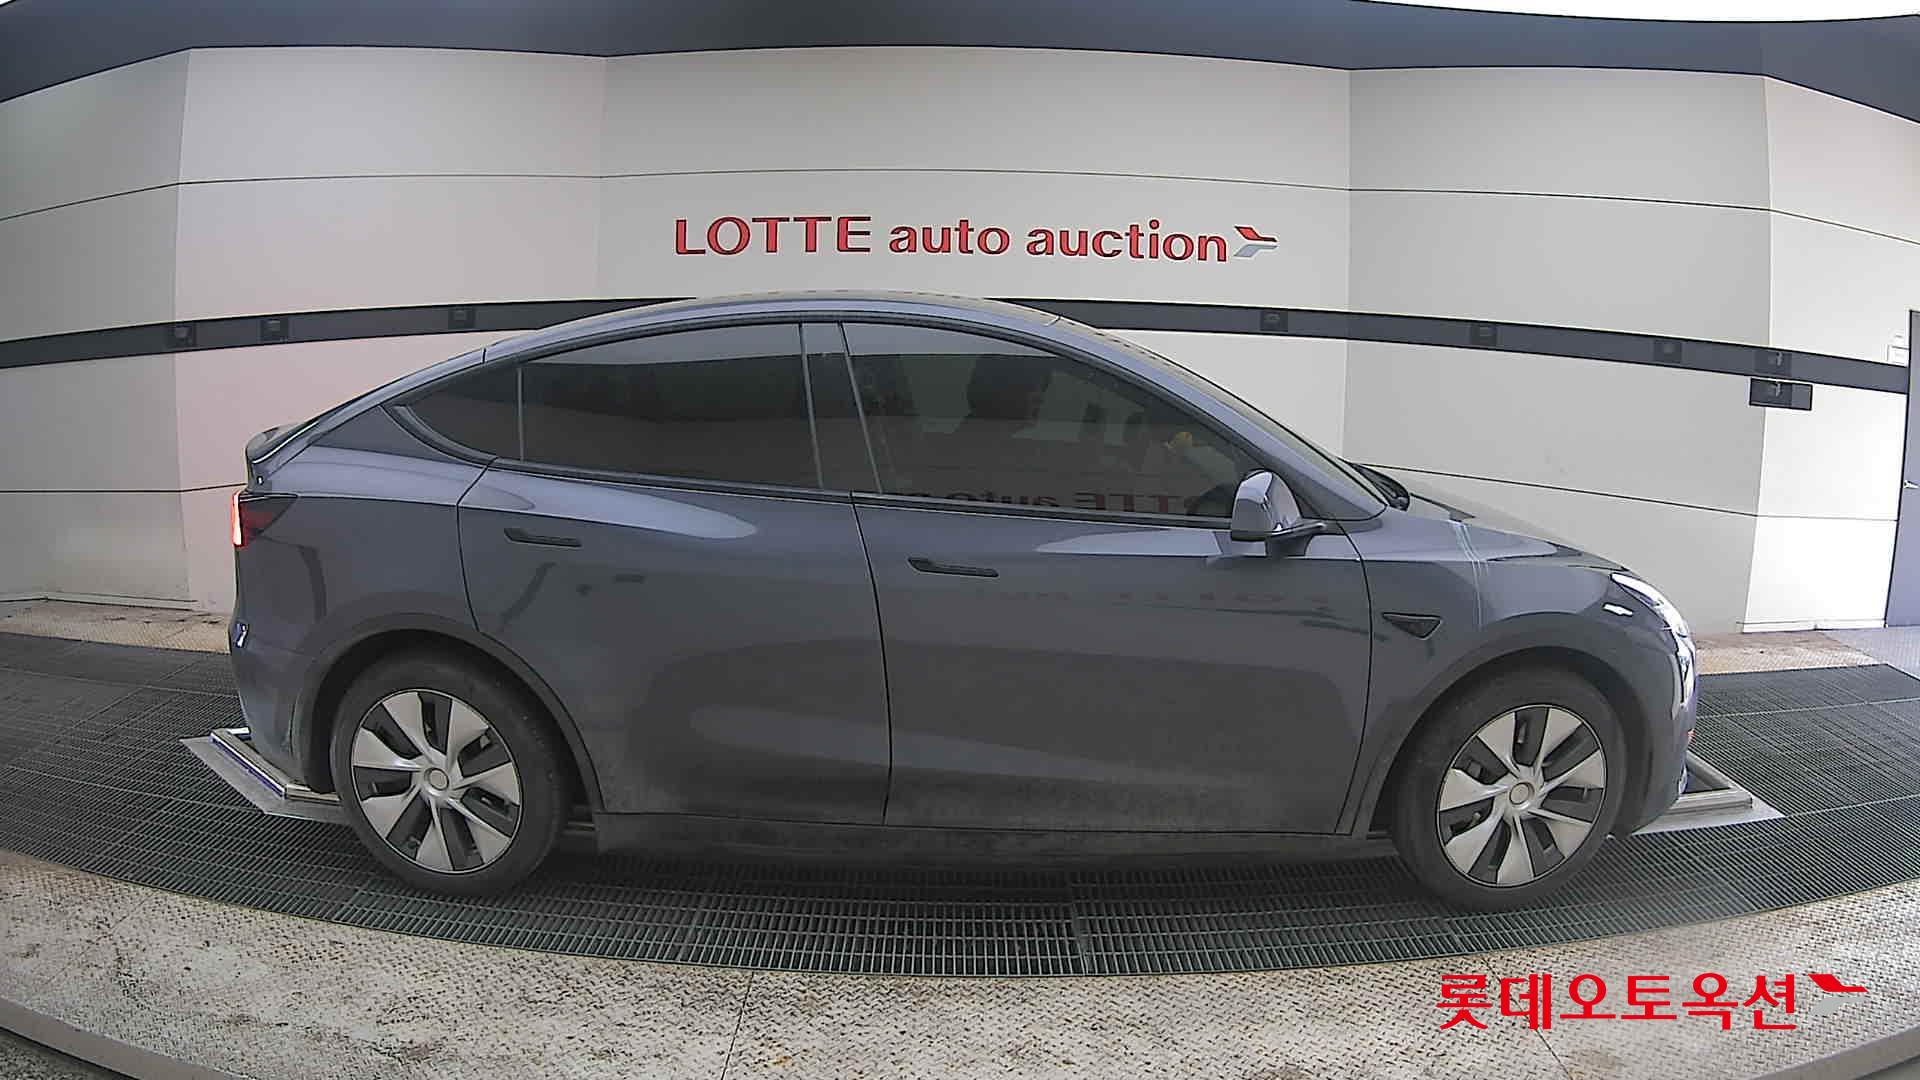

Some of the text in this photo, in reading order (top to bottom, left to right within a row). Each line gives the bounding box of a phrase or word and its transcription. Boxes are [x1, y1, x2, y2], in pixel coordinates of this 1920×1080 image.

[675, 216, 1227, 262] LOTTE auto auction
